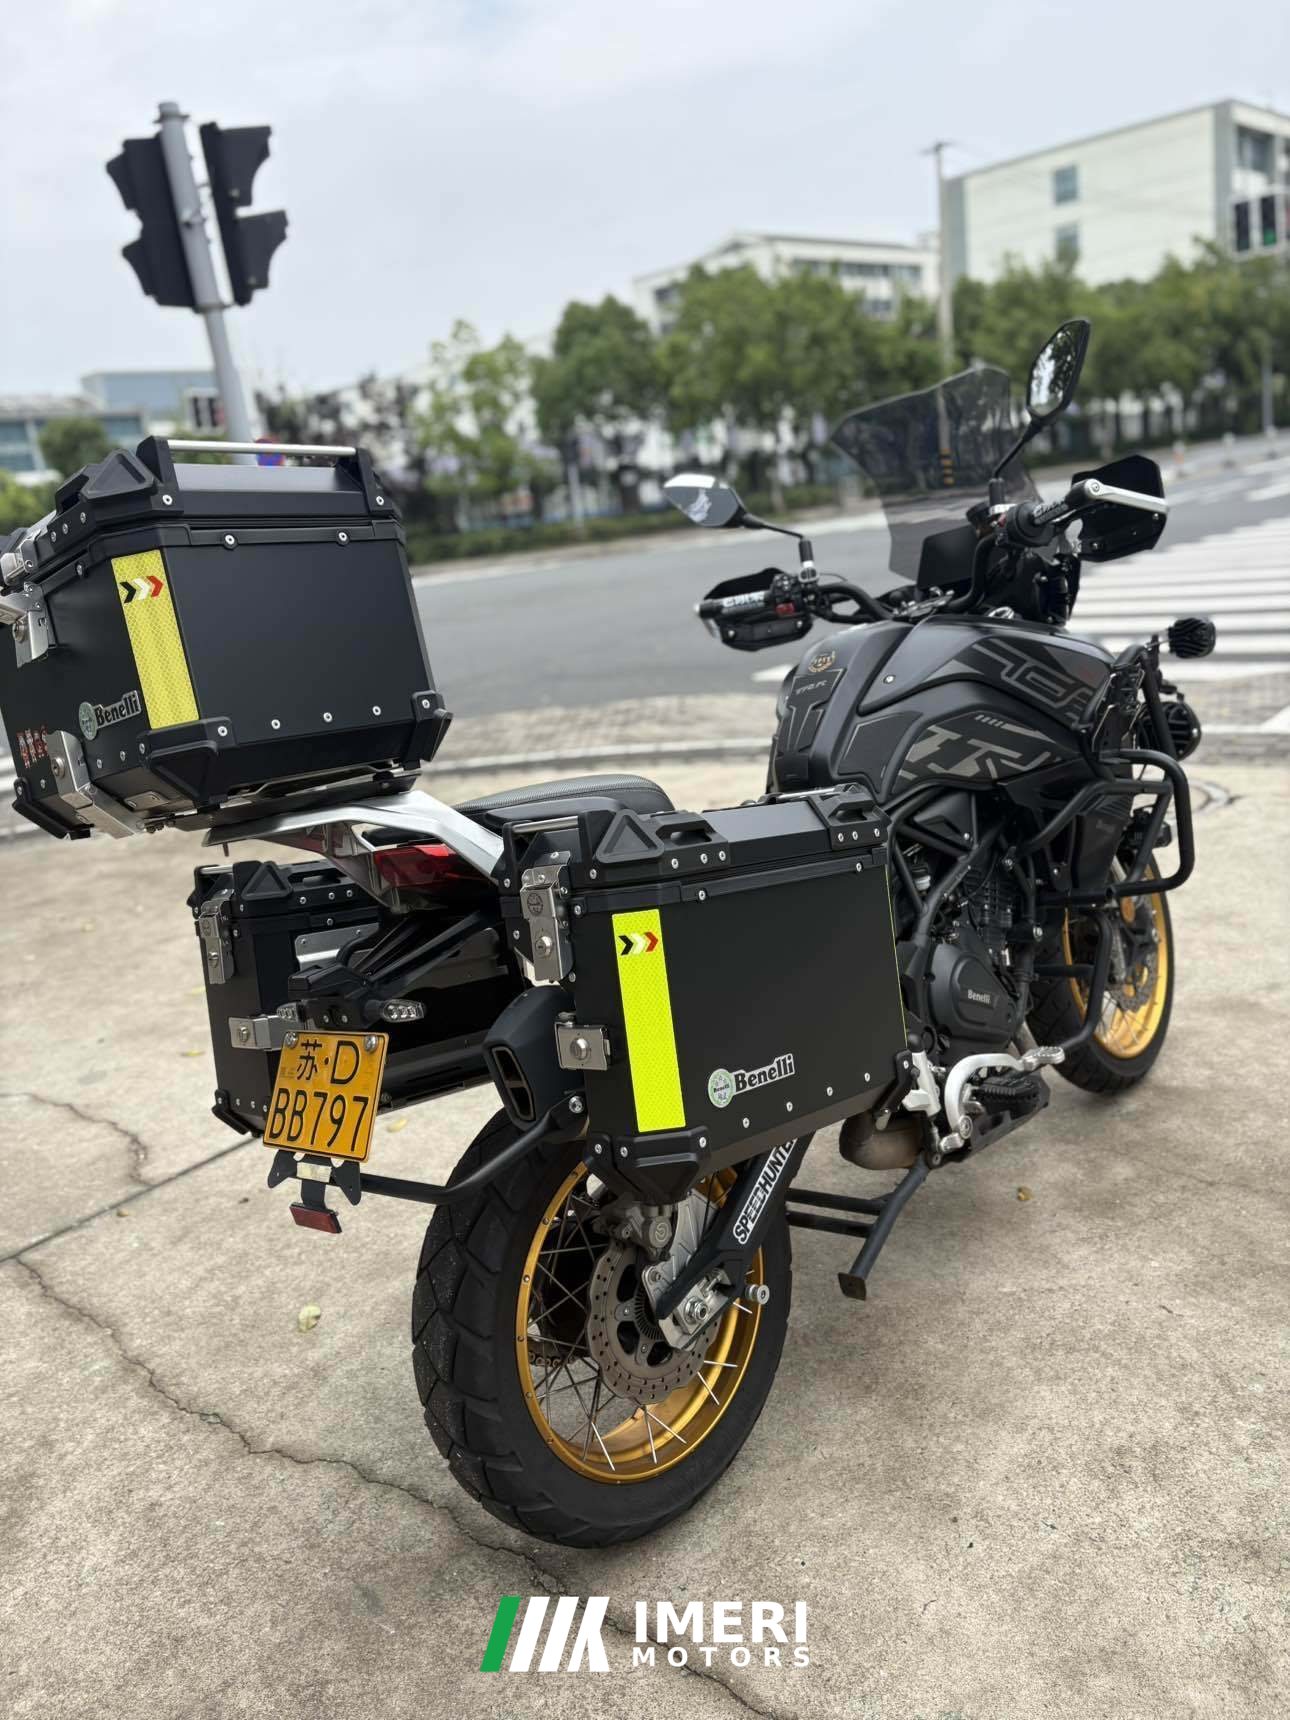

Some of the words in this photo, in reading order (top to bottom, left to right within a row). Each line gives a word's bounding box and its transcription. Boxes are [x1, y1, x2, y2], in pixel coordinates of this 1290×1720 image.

[94, 692, 140, 728] Benelli
[967, 988, 991, 1005] Benelli
[734, 1054, 794, 1093] Benelli
[268, 1087, 369, 1152] BB797
